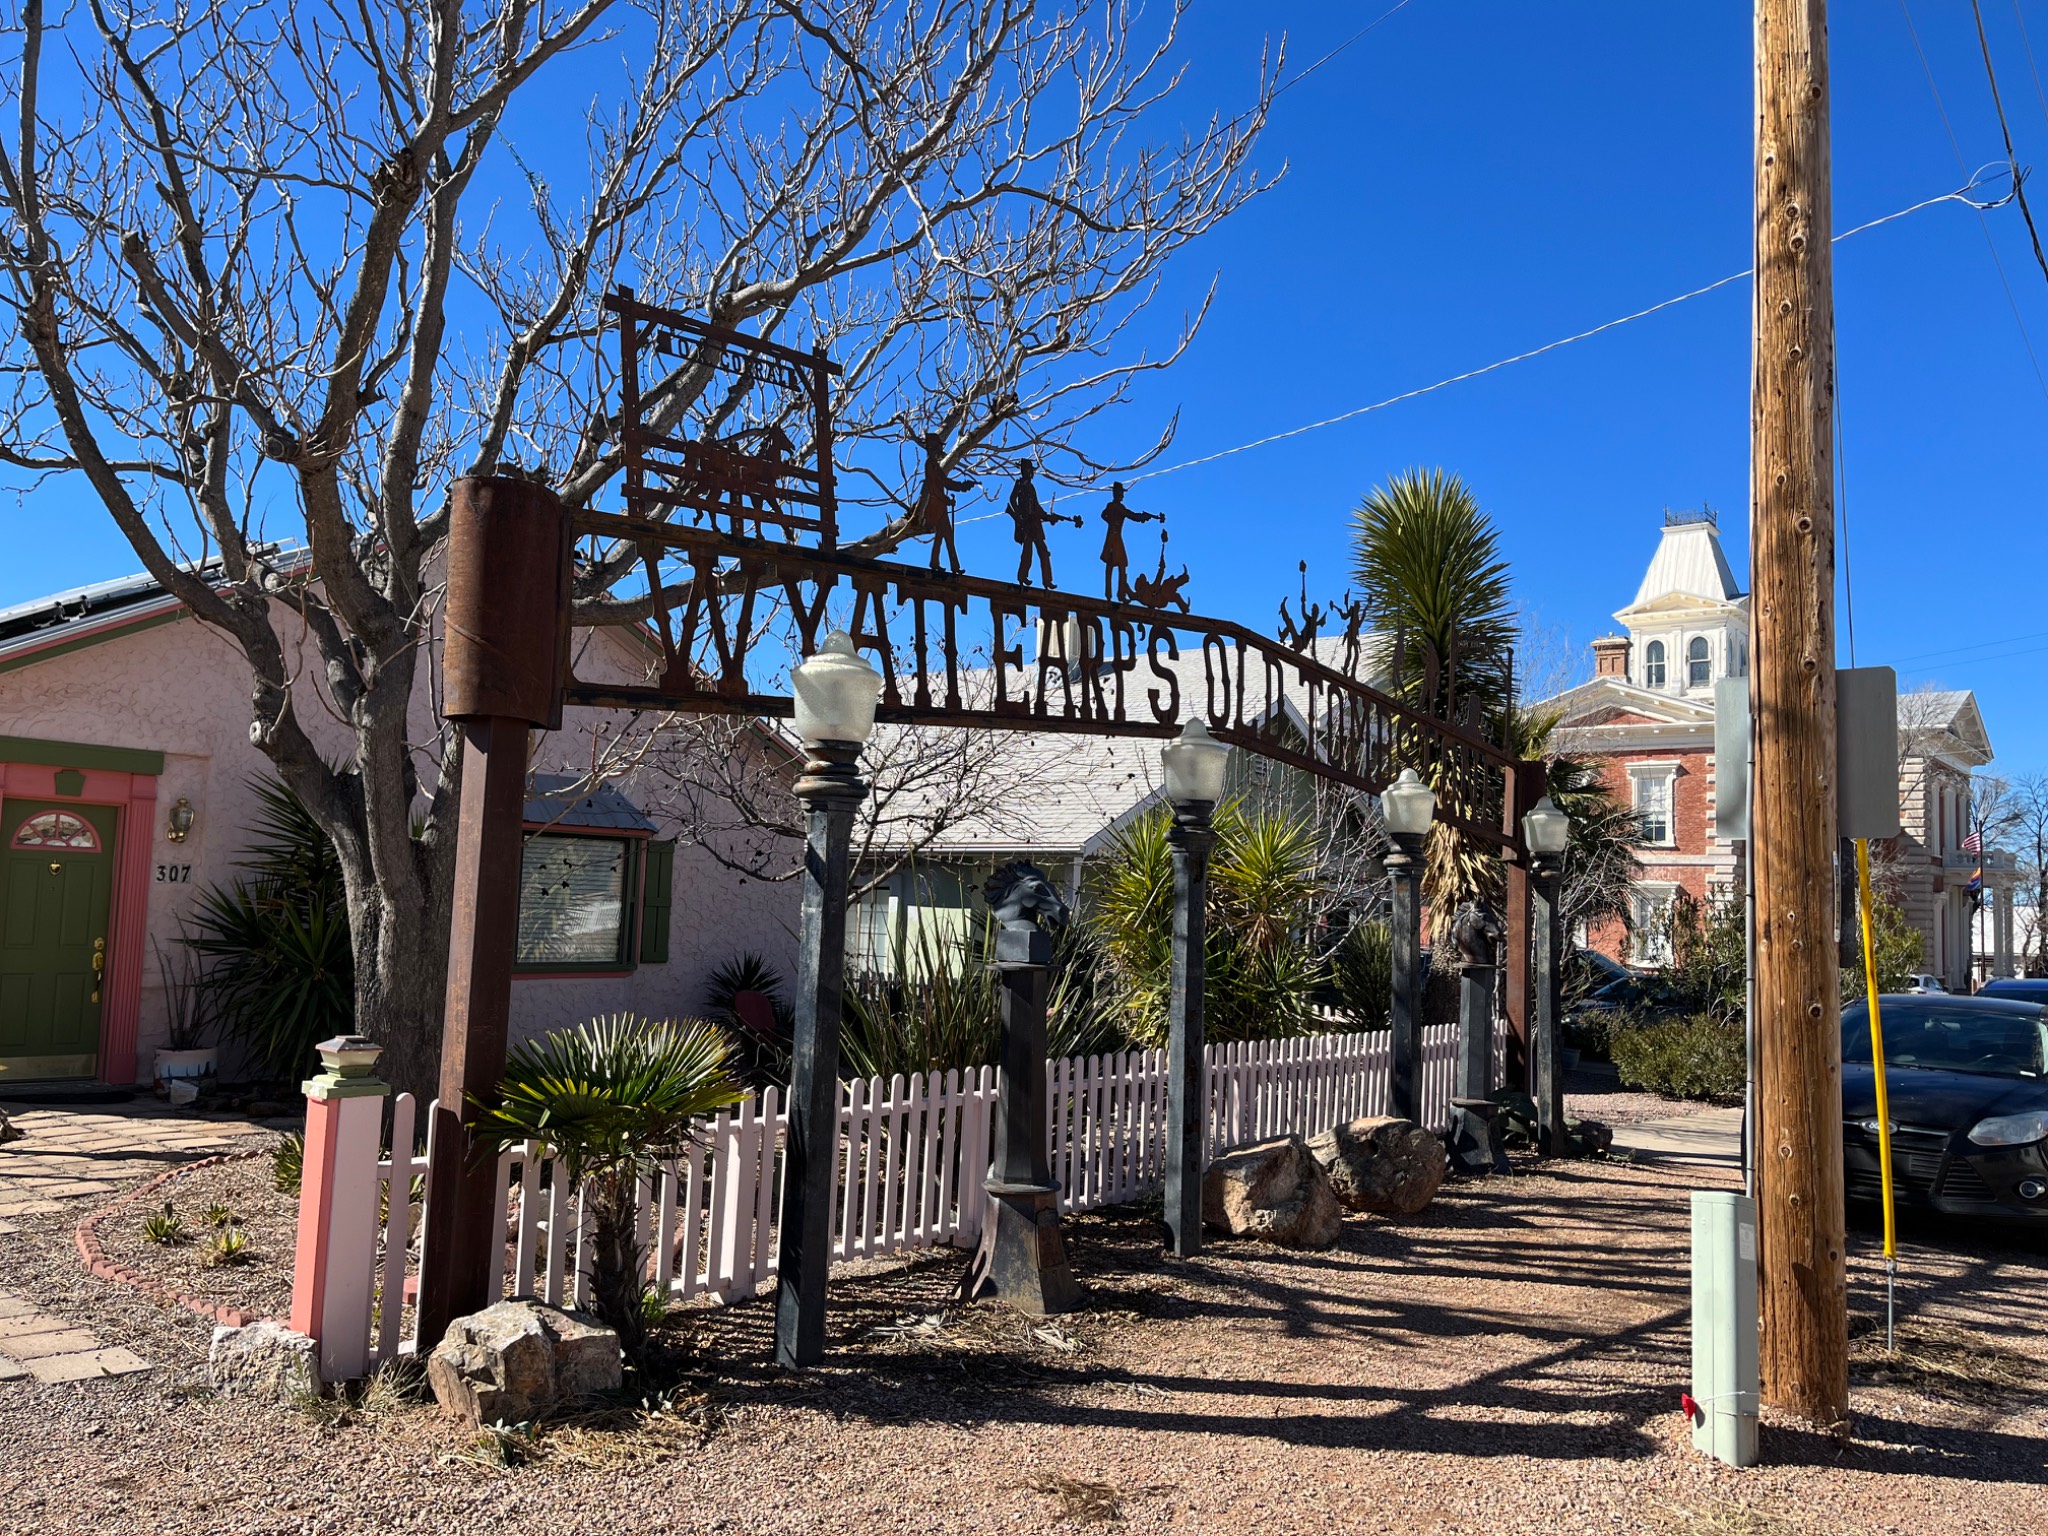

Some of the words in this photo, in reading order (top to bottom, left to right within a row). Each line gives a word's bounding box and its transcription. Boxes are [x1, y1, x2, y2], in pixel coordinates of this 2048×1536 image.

[720, 351, 787, 386] CORRAL
[636, 546, 967, 707] WYATT
[991, 600, 1180, 725] EARP'S
[1203, 633, 1284, 744] OLD
[157, 864, 191, 883] 307
